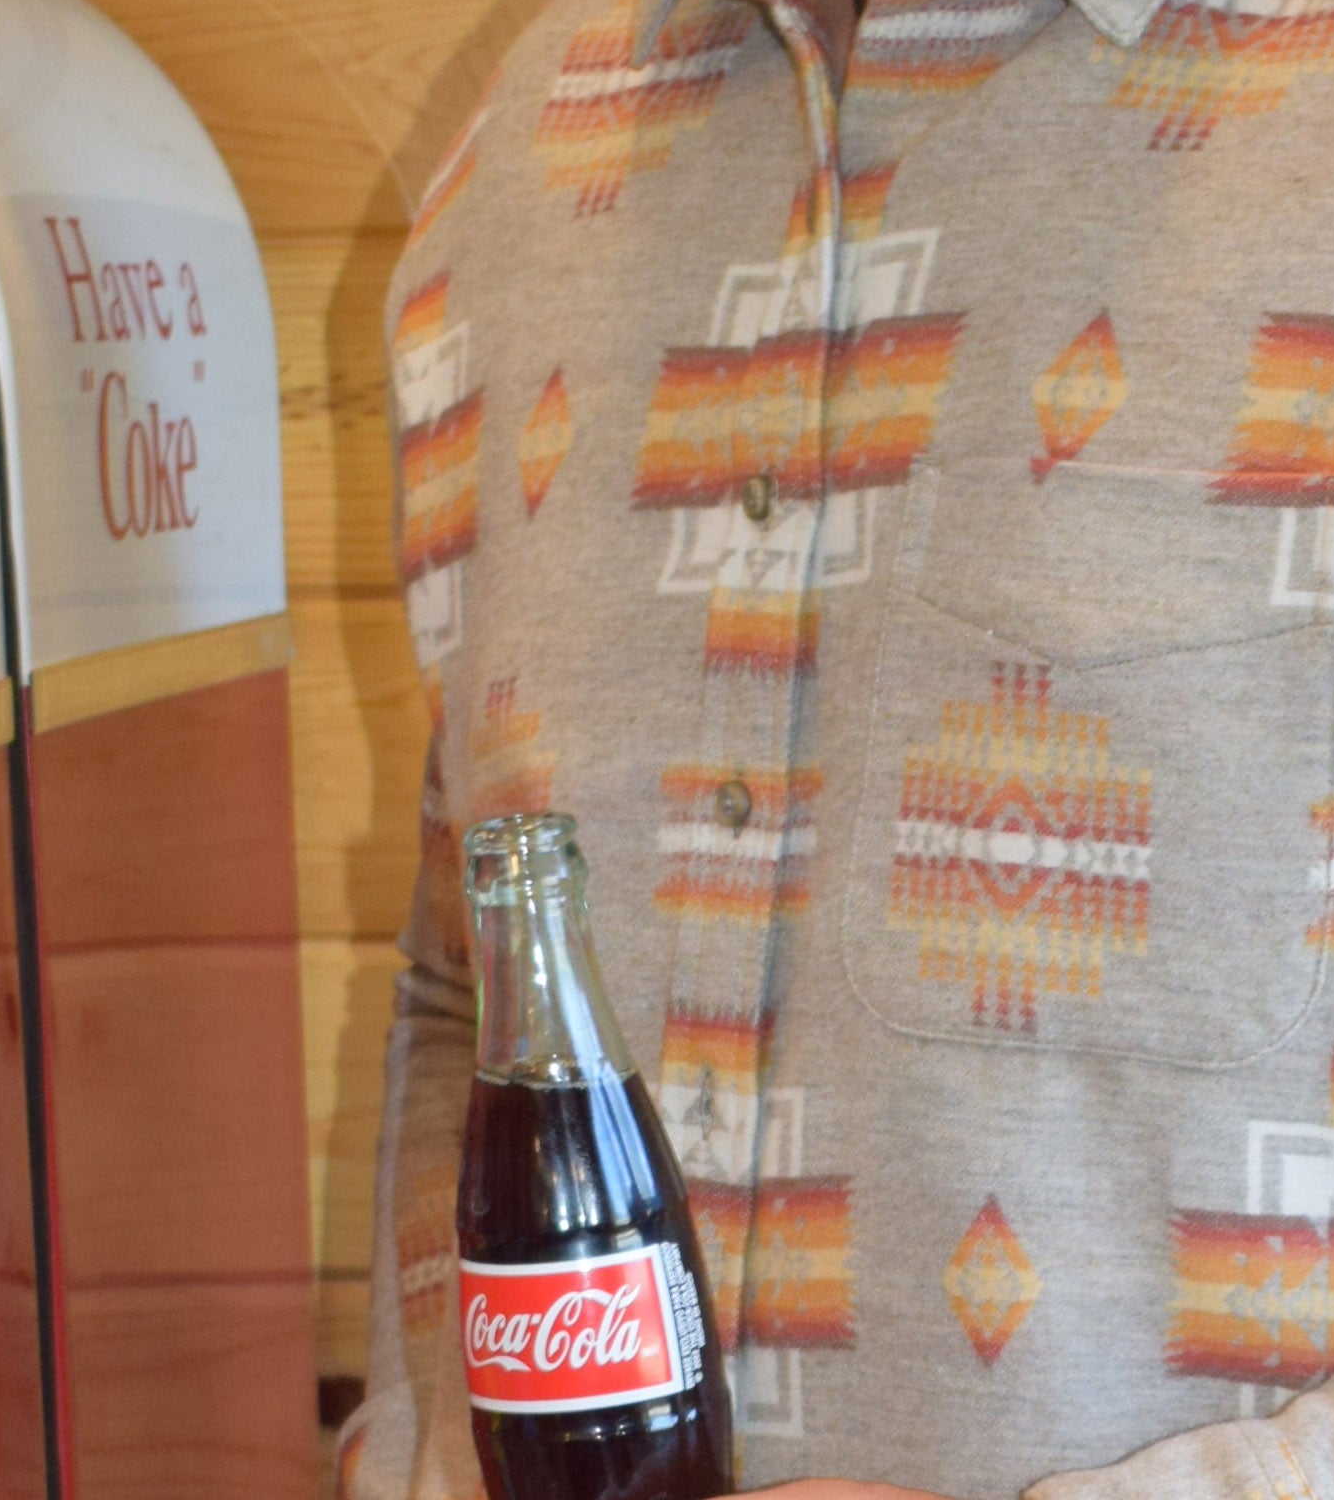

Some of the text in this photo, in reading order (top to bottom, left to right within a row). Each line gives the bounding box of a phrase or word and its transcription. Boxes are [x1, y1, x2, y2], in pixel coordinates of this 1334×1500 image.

[43, 216, 207, 342] Have a
[467, 1284, 641, 1373] Coca-Cola
